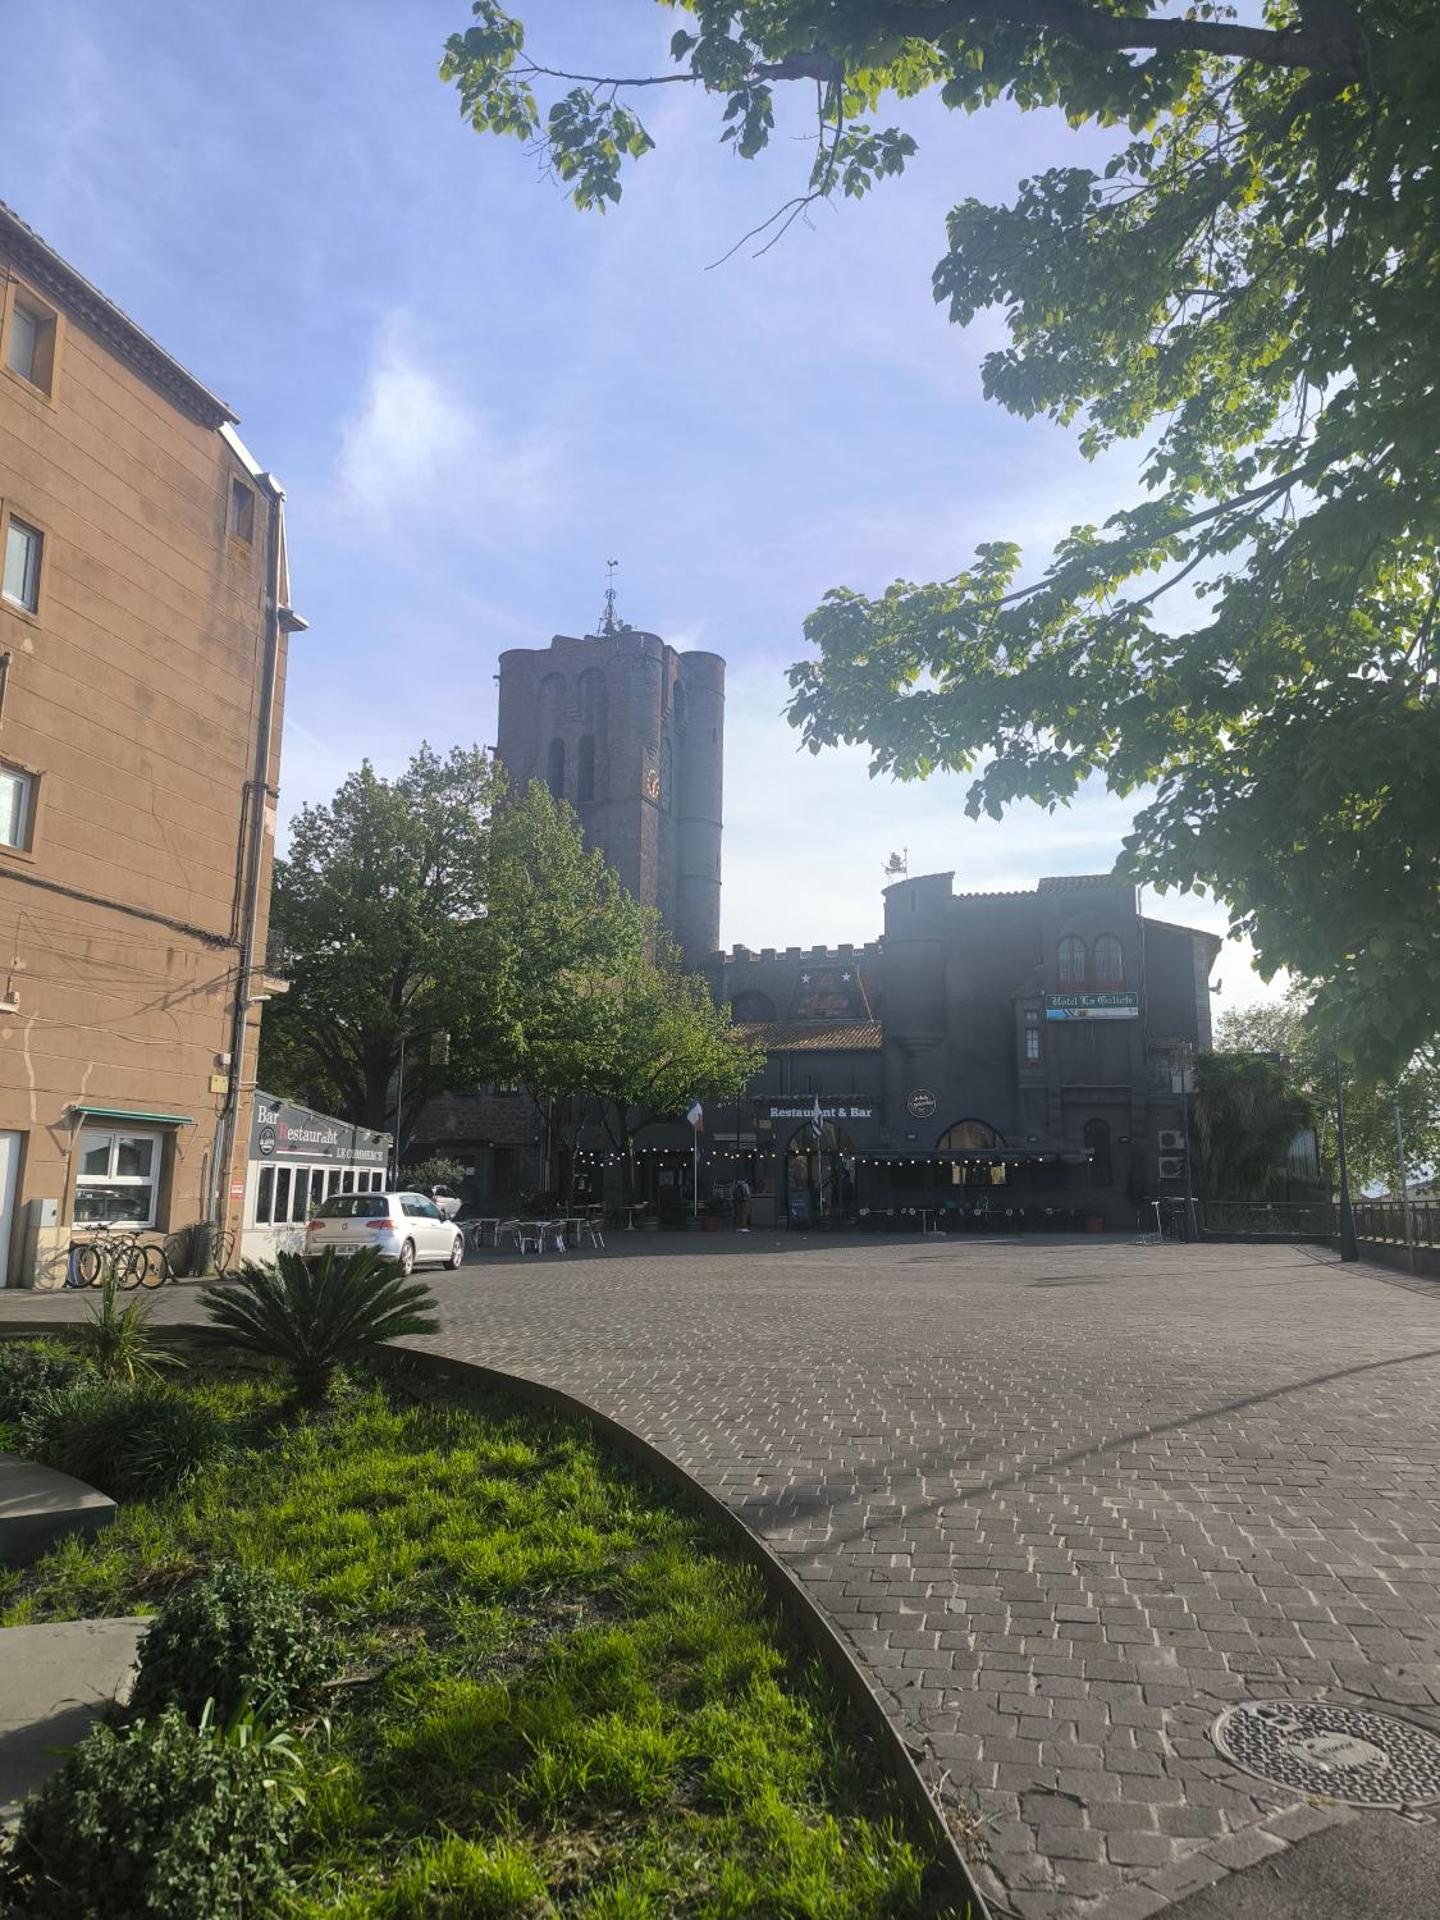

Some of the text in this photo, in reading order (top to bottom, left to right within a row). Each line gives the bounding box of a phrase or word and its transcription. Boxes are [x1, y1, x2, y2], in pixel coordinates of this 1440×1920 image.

[257, 1105, 279, 1124] Bar
[770, 1107, 873, 1118] Restaunt & Bar
[278, 1121, 338, 1145] Restaurant
